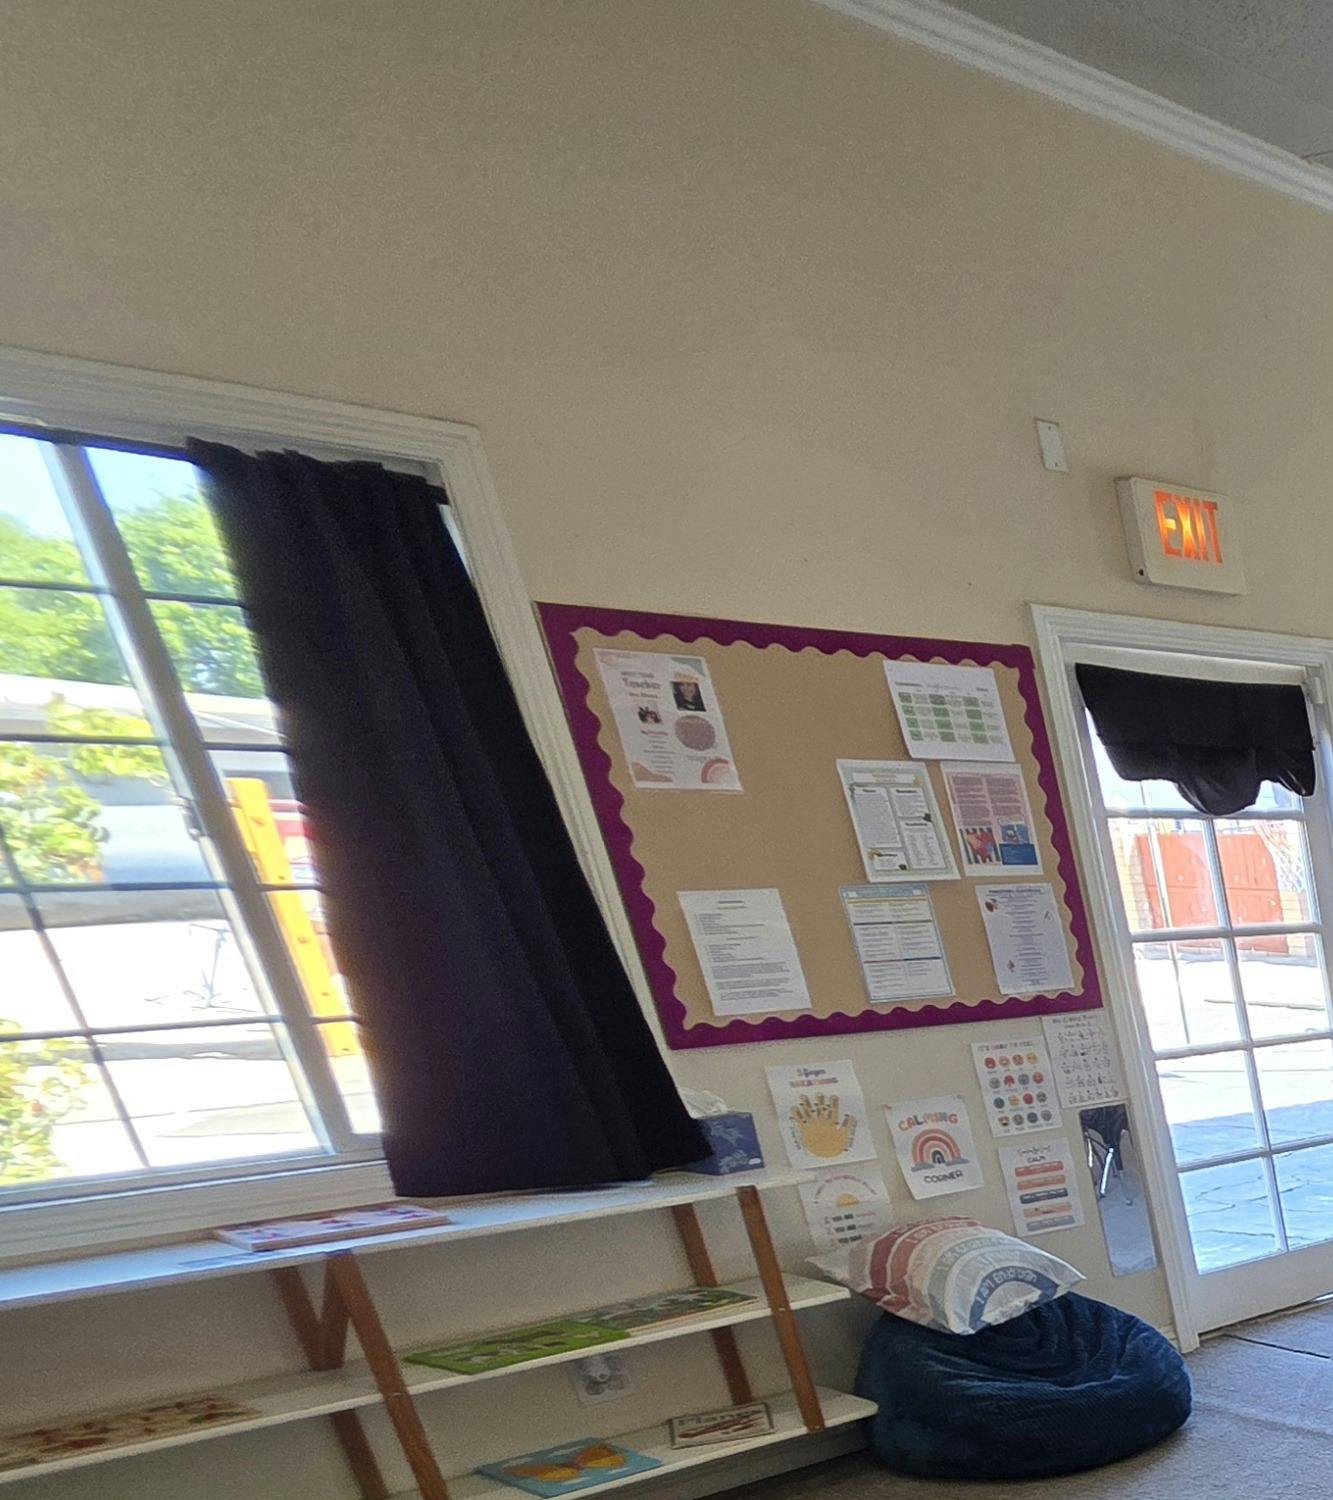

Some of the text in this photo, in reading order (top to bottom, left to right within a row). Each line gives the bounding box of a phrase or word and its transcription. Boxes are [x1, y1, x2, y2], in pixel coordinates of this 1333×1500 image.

[1154, 490, 1223, 564] EXIT
[898, 1112, 959, 1132] CALMING
[923, 1170, 963, 1184] CORNER
